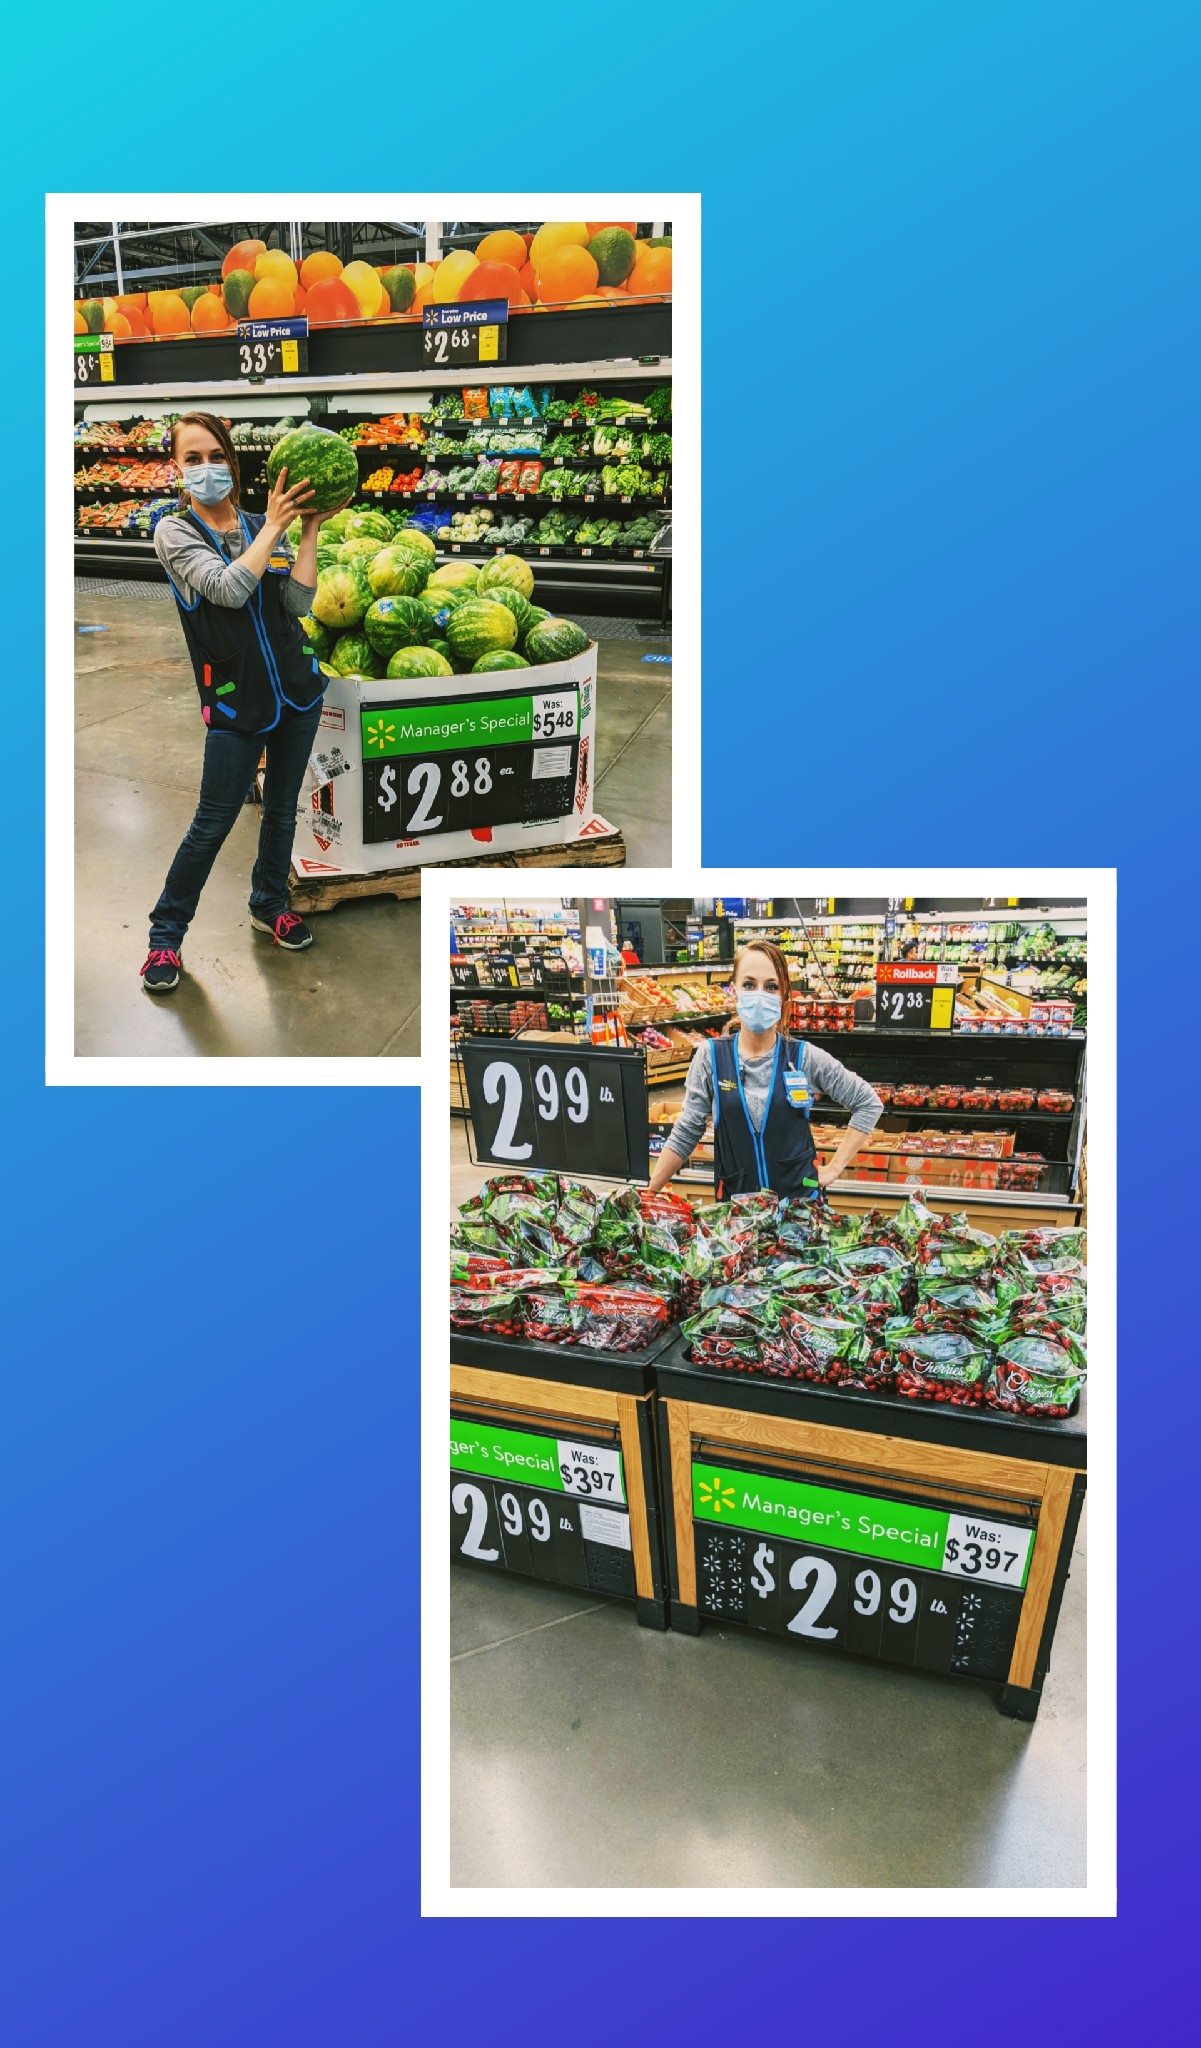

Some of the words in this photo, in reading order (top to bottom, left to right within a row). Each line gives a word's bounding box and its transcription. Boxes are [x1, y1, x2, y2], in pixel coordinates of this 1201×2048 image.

[441, 314, 462, 324] Low
[463, 312, 488, 322] Price
[252, 328, 269, 338] Low
[270, 327, 290, 336] Price
[543, 699, 563, 710] Was:
[400, 719, 476, 740] Manager's
[480, 711, 531, 734] Special
[499, 766, 515, 776] ea.
[893, 968, 936, 979] Rollback
[599, 1086, 615, 1103] lb.
[790, 1322, 838, 1350] Cherries
[912, 1356, 965, 1376] Cherries
[1005, 1371, 1055, 1398] Cherries
[493, 1446, 555, 1472] Special
[571, 1450, 599, 1466] Was:
[559, 1517, 574, 1532] lb.
[741, 1492, 851, 1531] Manager's
[858, 1516, 939, 1550] Special
[965, 1524, 1002, 1544] Was:
[929, 1598, 949, 1616] lb.
